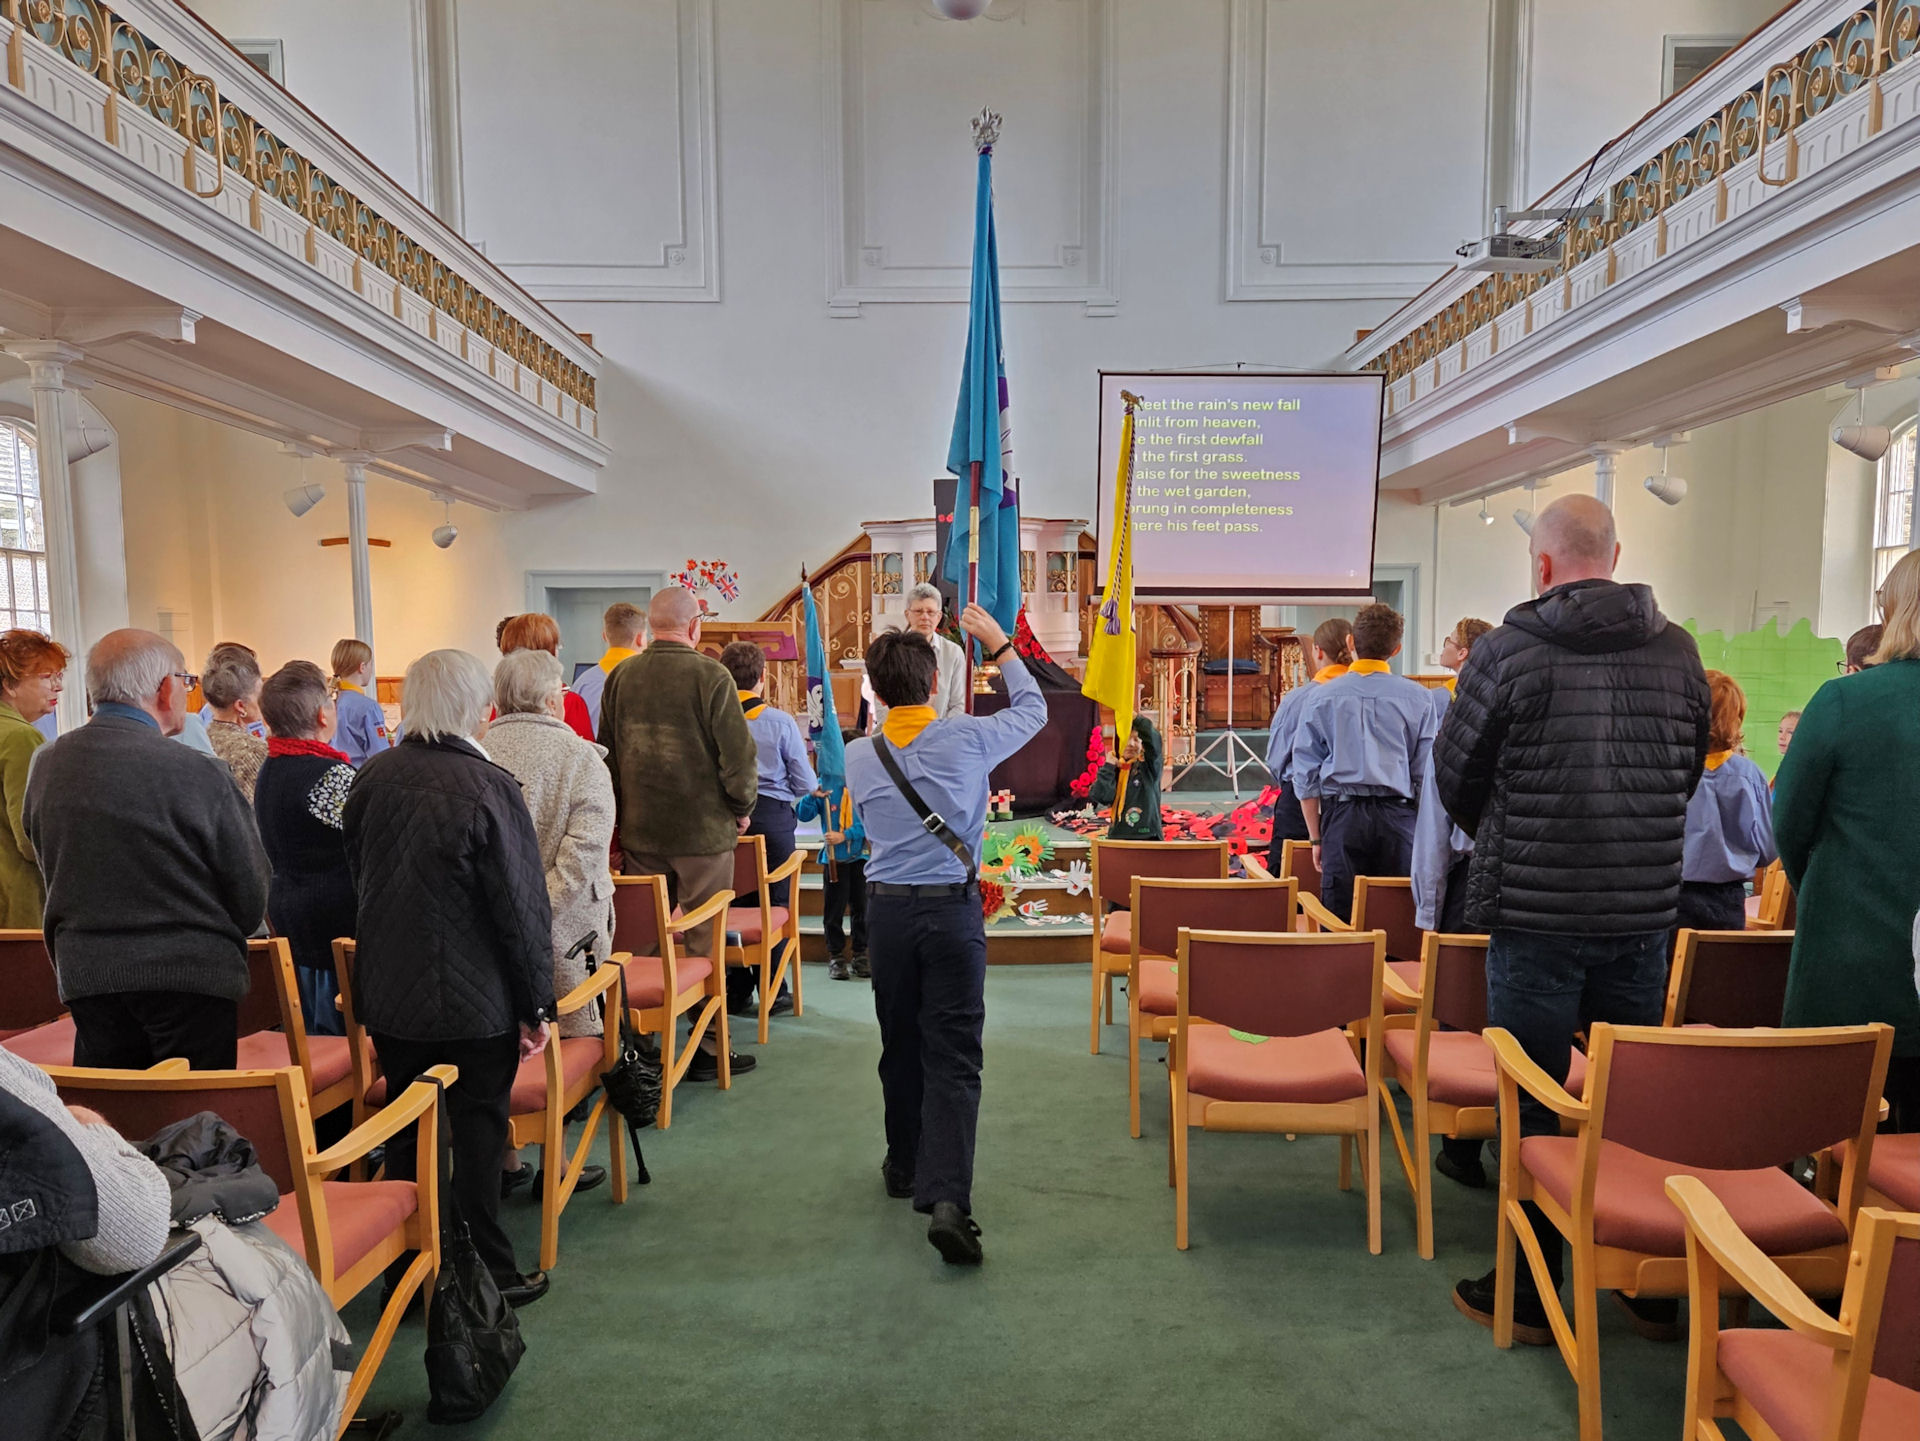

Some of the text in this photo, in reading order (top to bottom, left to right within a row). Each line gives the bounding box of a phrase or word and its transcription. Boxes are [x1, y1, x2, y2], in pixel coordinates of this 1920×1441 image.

[1171, 399, 1194, 410] the
[1198, 398, 1239, 411] rain's
[1243, 401, 1273, 411] new
[1277, 398, 1301, 411] fall
[1165, 416, 1198, 428] from
[1203, 416, 1261, 429] heaven,
[1150, 433, 1173, 445] the
[1177, 433, 1207, 445] first
[1210, 433, 1263, 445] dewfall
[1142, 450, 1165, 462] the
[1169, 451, 1198, 462] first
[1202, 453, 1248, 465] grass.
[1135, 468, 1301, 480] aise for the sweetness
[1137, 484, 1251, 500] the wet garden,
[1173, 502, 1187, 514] in
[1191, 503, 1294, 517] completeness
[1167, 520, 1188, 532] his
[1191, 520, 1220, 532] feet
[1224, 522, 1263, 534] pass.
